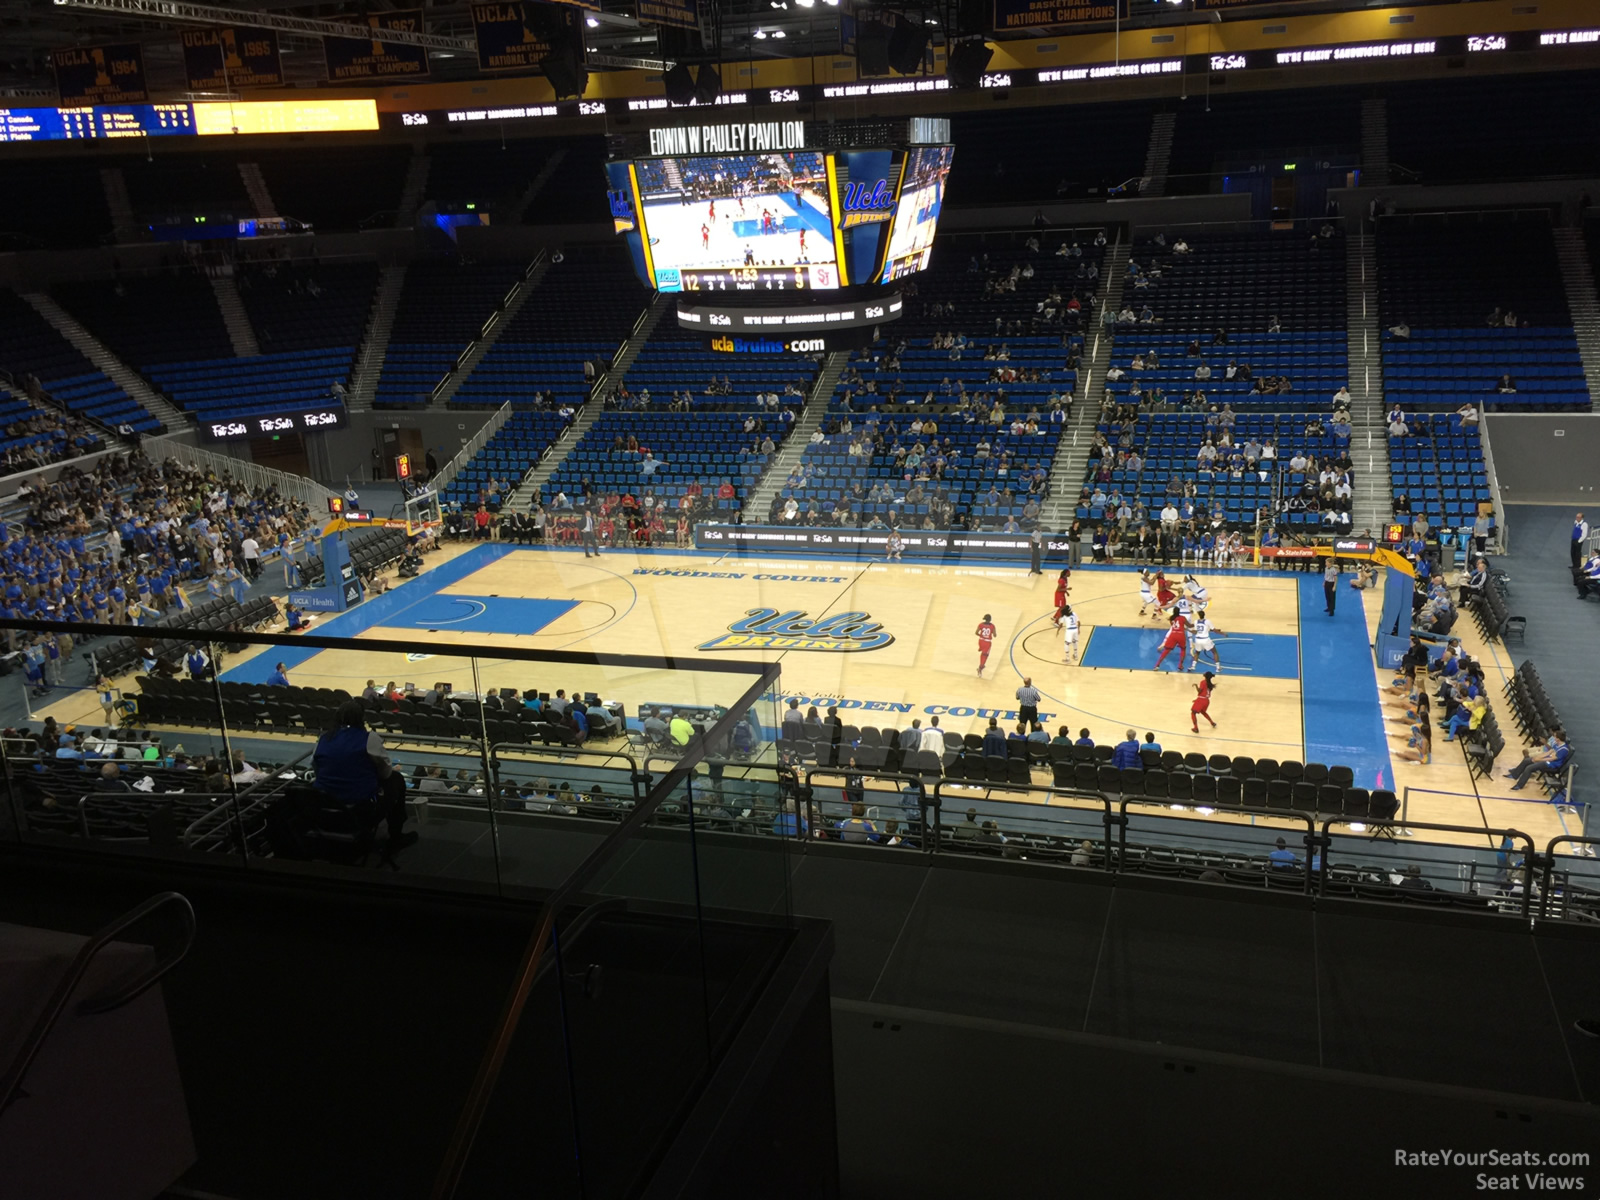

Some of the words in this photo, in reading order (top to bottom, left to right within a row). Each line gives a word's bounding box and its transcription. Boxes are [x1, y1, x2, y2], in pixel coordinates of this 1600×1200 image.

[476, 5, 517, 24] UCLA
[1007, 11, 1053, 26] NATIONAL
[1057, 6, 1116, 20] CHAMPIONS
[184, 32, 220, 48] UCLA
[1540, 33, 1567, 45] WE'RE
[56, 50, 90, 66] UCLA
[489, 55, 526, 66] NATIONAL
[1276, 52, 1302, 64] WE'RE
[1303, 50, 1332, 62] MAKIN'
[1334, 45, 1388, 60] SANDWICHES
[1390, 44, 1412, 55] OVER
[1414, 42, 1436, 54] HERE
[335, 65, 372, 78] NATIONAL
[377, 61, 420, 74] CHAMPIONS
[1038, 70, 1060, 82] WE'RE
[1141, 62, 1160, 74] OVER
[1162, 61, 1181, 72] HERE
[191, 77, 230, 89] NATIONAL
[233, 74, 278, 85] CHAMPIONS
[824, 87, 844, 97] WE'RE
[650, 127, 687, 156] EDWIN
[688, 126, 701, 154] W
[702, 124, 746, 152] PAULEY
[748, 121, 805, 150] PAVILION
[844, 212, 890, 228] BRUINS
[685, 275, 700, 290] 12
[794, 274, 804, 288] 9
[260, 420, 275, 432] Fat
[304, 415, 320, 426] Fat
[212, 425, 228, 437] Fat
[632, 568, 748, 580] WOODEN
[752, 574, 849, 584] COURT
[312, 598, 335, 607] Health
[982, 628, 991, 636] 20
[715, 634, 861, 650] BRUINS
[759, 693, 916, 713] WOODEN
[923, 704, 1058, 723] COURT
